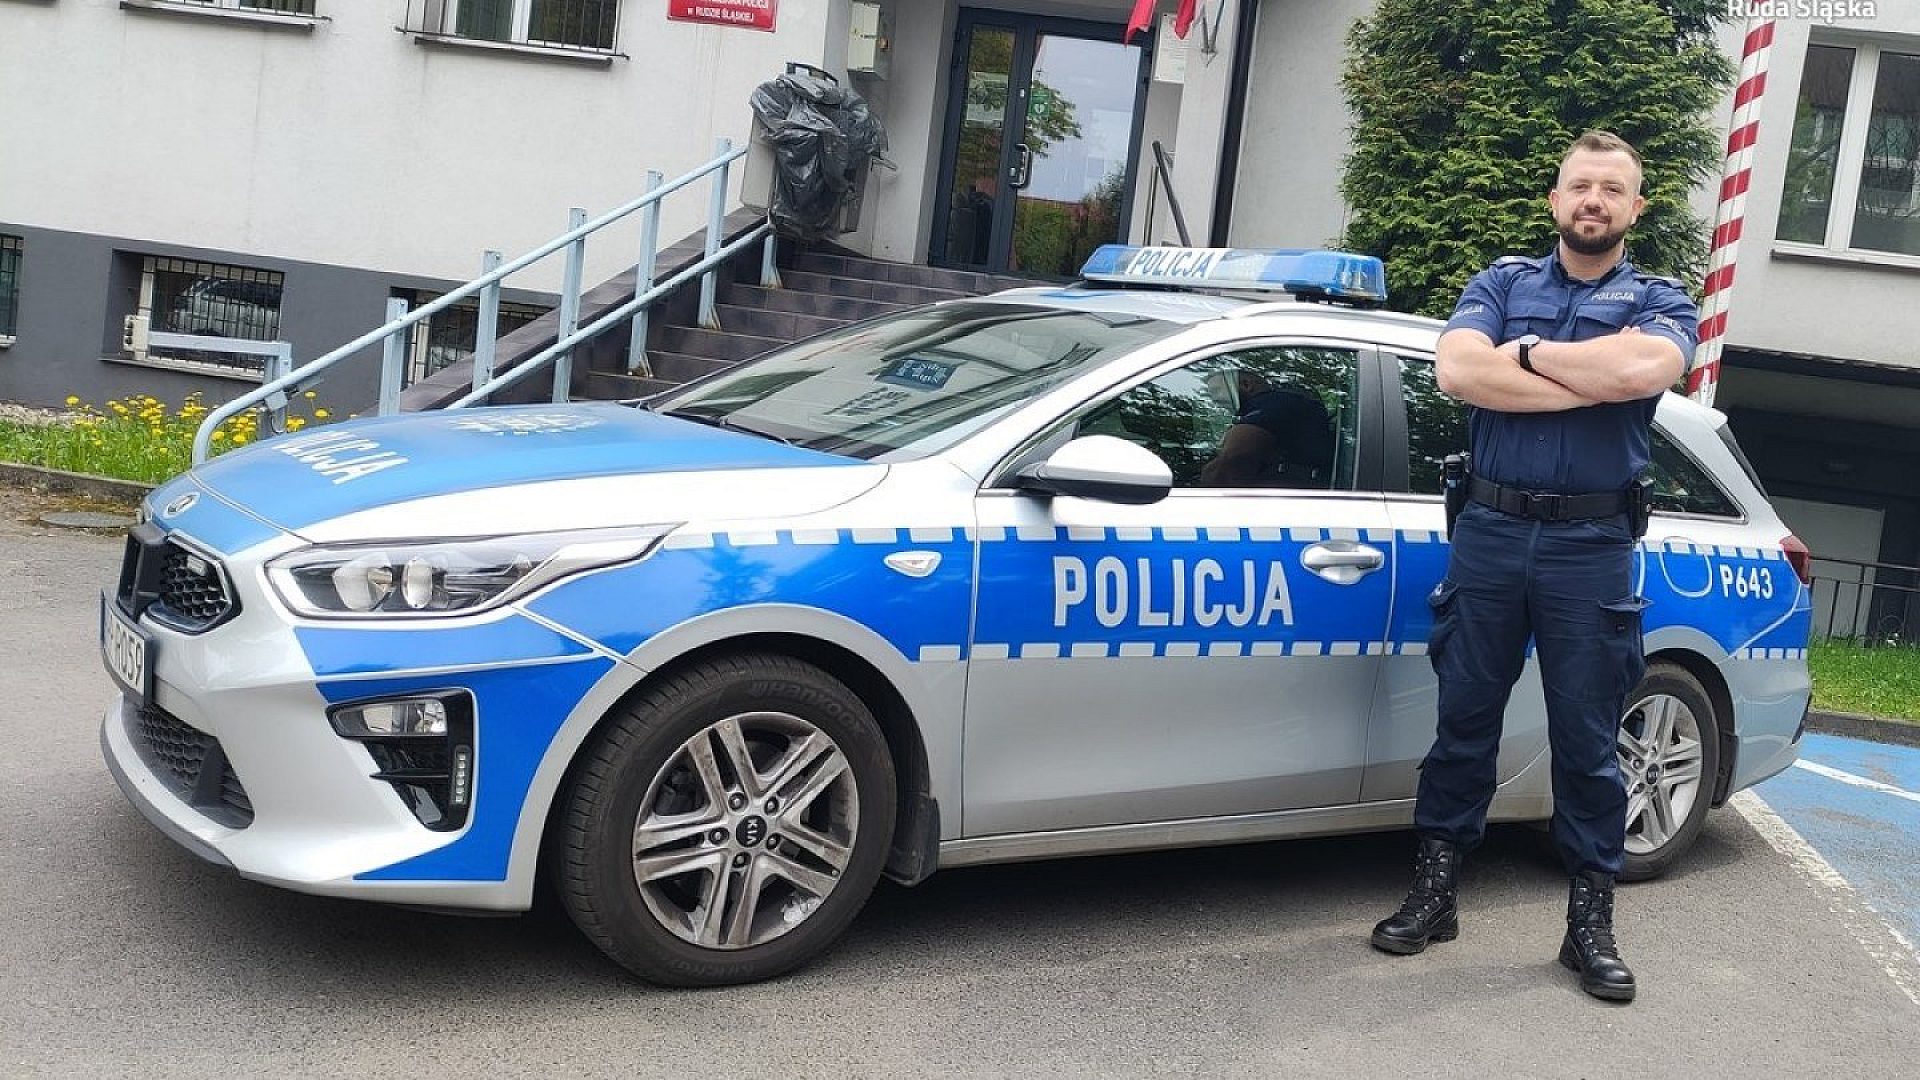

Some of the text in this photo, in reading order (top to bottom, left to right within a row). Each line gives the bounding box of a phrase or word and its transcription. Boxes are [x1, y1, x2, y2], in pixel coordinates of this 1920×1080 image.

[1129, 249, 1214, 277] POLICJA
[271, 430, 409, 485] LICJA
[1053, 555, 1294, 627] POLICJA
[1719, 563, 1773, 600] P643
[747, 819, 757, 845] KIA
